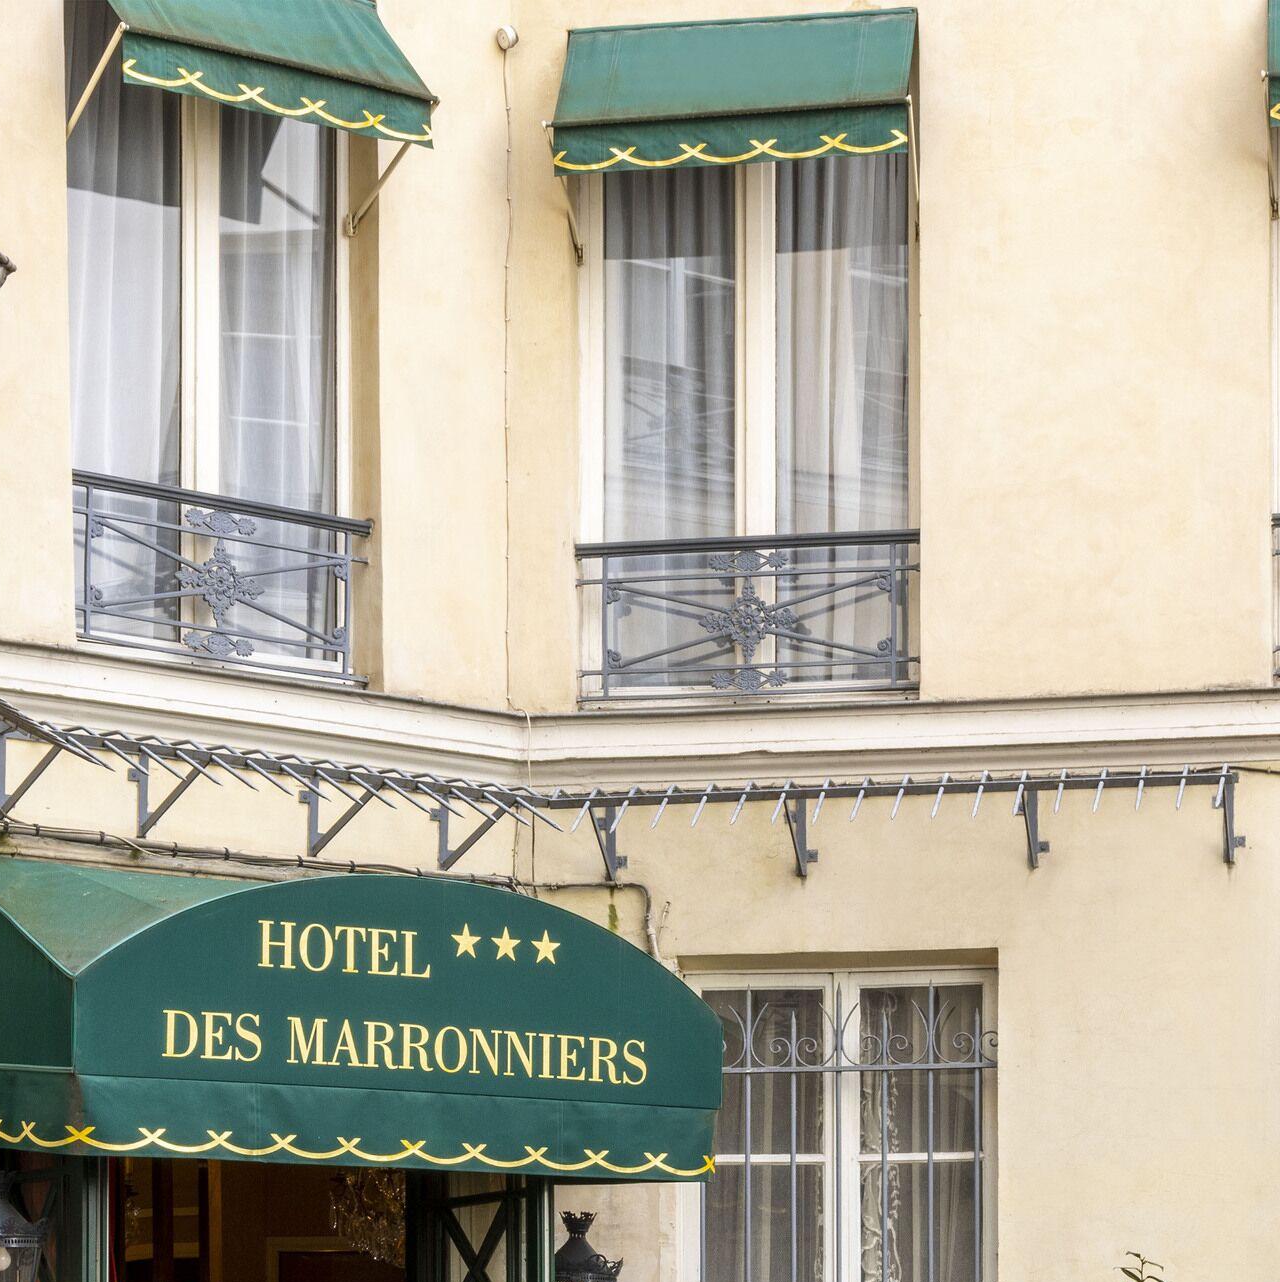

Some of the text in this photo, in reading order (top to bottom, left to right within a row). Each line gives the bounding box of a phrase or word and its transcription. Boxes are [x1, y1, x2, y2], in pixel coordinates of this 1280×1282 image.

[258, 920, 430, 978] HOTEL
[162, 1010, 646, 1085] DES MARRONNIERS
